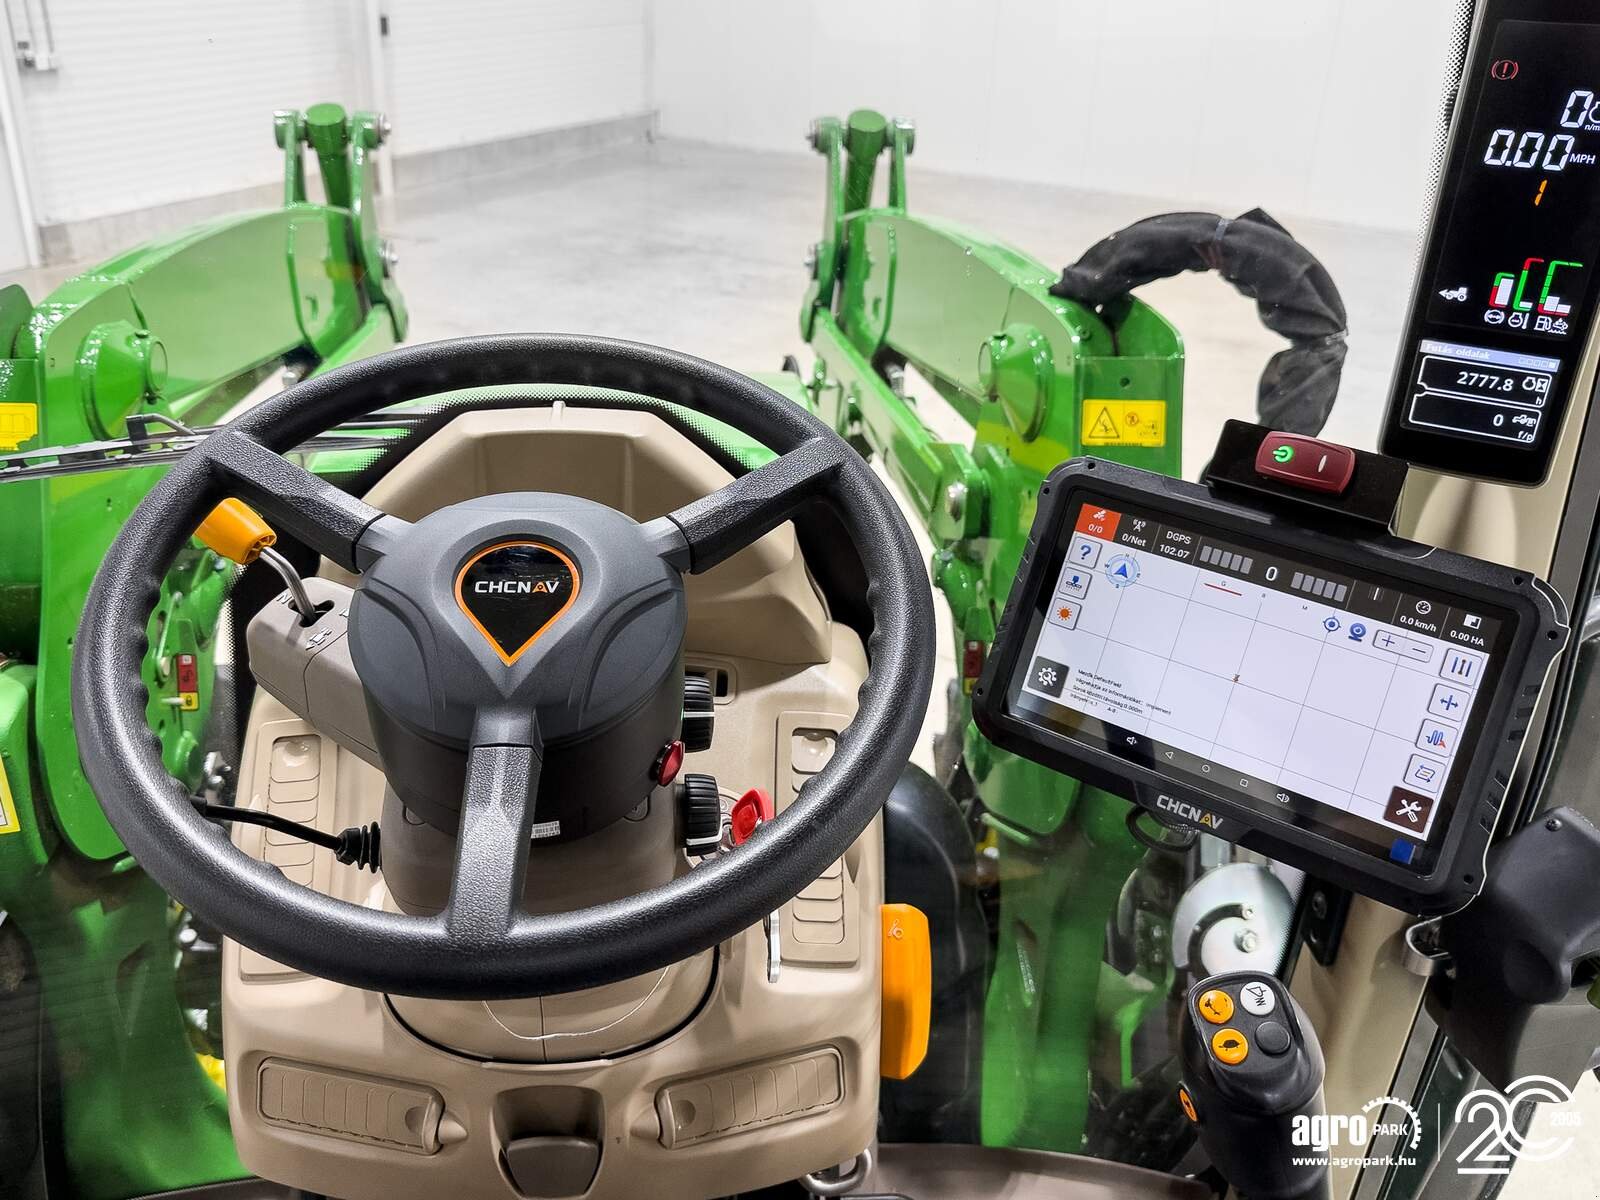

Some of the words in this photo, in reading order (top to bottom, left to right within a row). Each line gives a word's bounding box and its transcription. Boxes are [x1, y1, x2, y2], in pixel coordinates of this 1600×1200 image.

[1484, 129, 1575, 171] 0.00
[1569, 153, 1596, 164] MPH
[1457, 371, 1514, 391] 2777.8
[1088, 523, 1103, 534] 0/0
[1121, 533, 1147, 547] 0/Net
[1166, 530, 1192, 545] DGPS
[1159, 543, 1190, 559] 102.07
[1265, 566, 1278, 581] 0
[474, 581, 560, 593] CHCNAV
[1400, 615, 1414, 625] 0.0
[1414, 619, 1437, 632] km/h
[1450, 630, 1470, 641] 0.00
[1470, 636, 1485, 646] HA
[1156, 794, 1224, 830] CHCNAV
